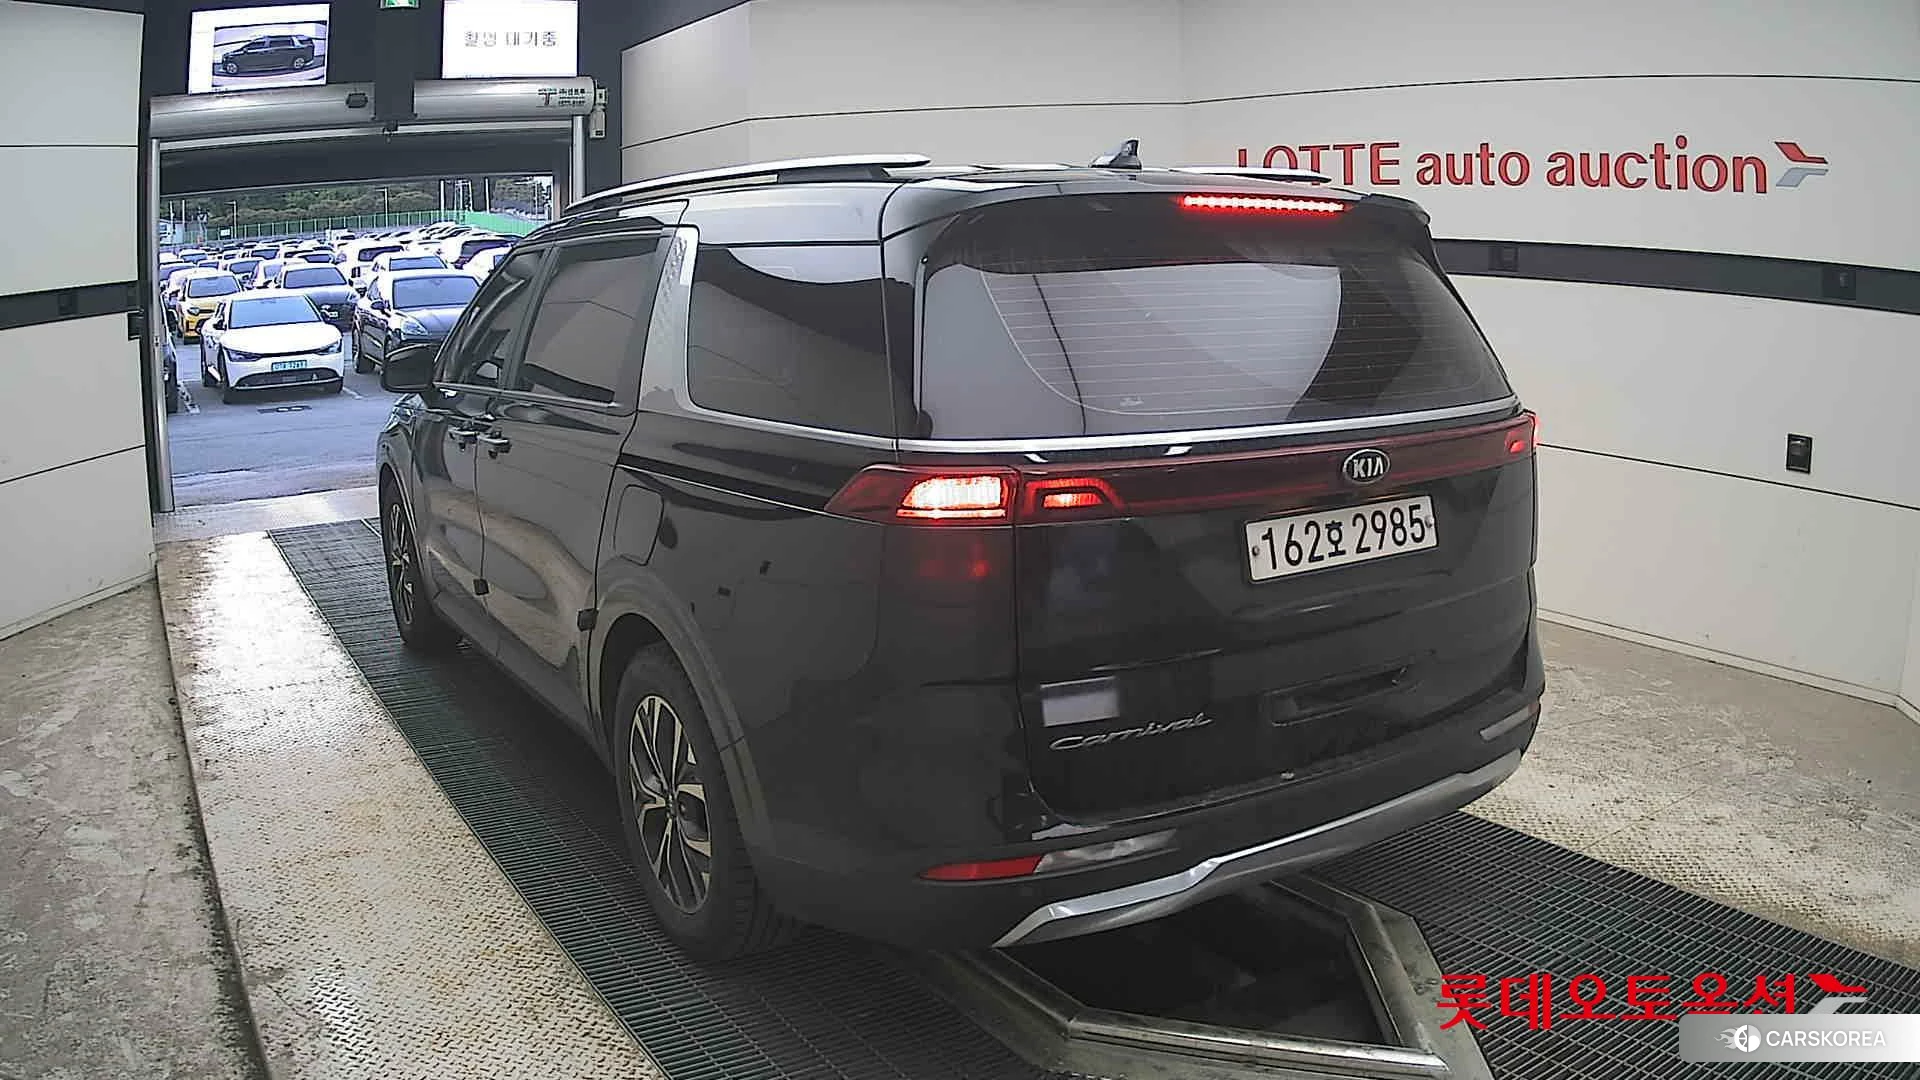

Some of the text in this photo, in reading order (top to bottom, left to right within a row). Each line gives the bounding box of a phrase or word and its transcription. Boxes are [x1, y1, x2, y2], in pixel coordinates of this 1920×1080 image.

[505, 30, 558, 47] 대기중
[1416, 143, 1530, 186] auto
[1546, 135, 1768, 194] auction
[1353, 456, 1384, 478] KIA
[1261, 504, 1425, 570] 162호 2985
[1050, 712, 1213, 751] Carnival
